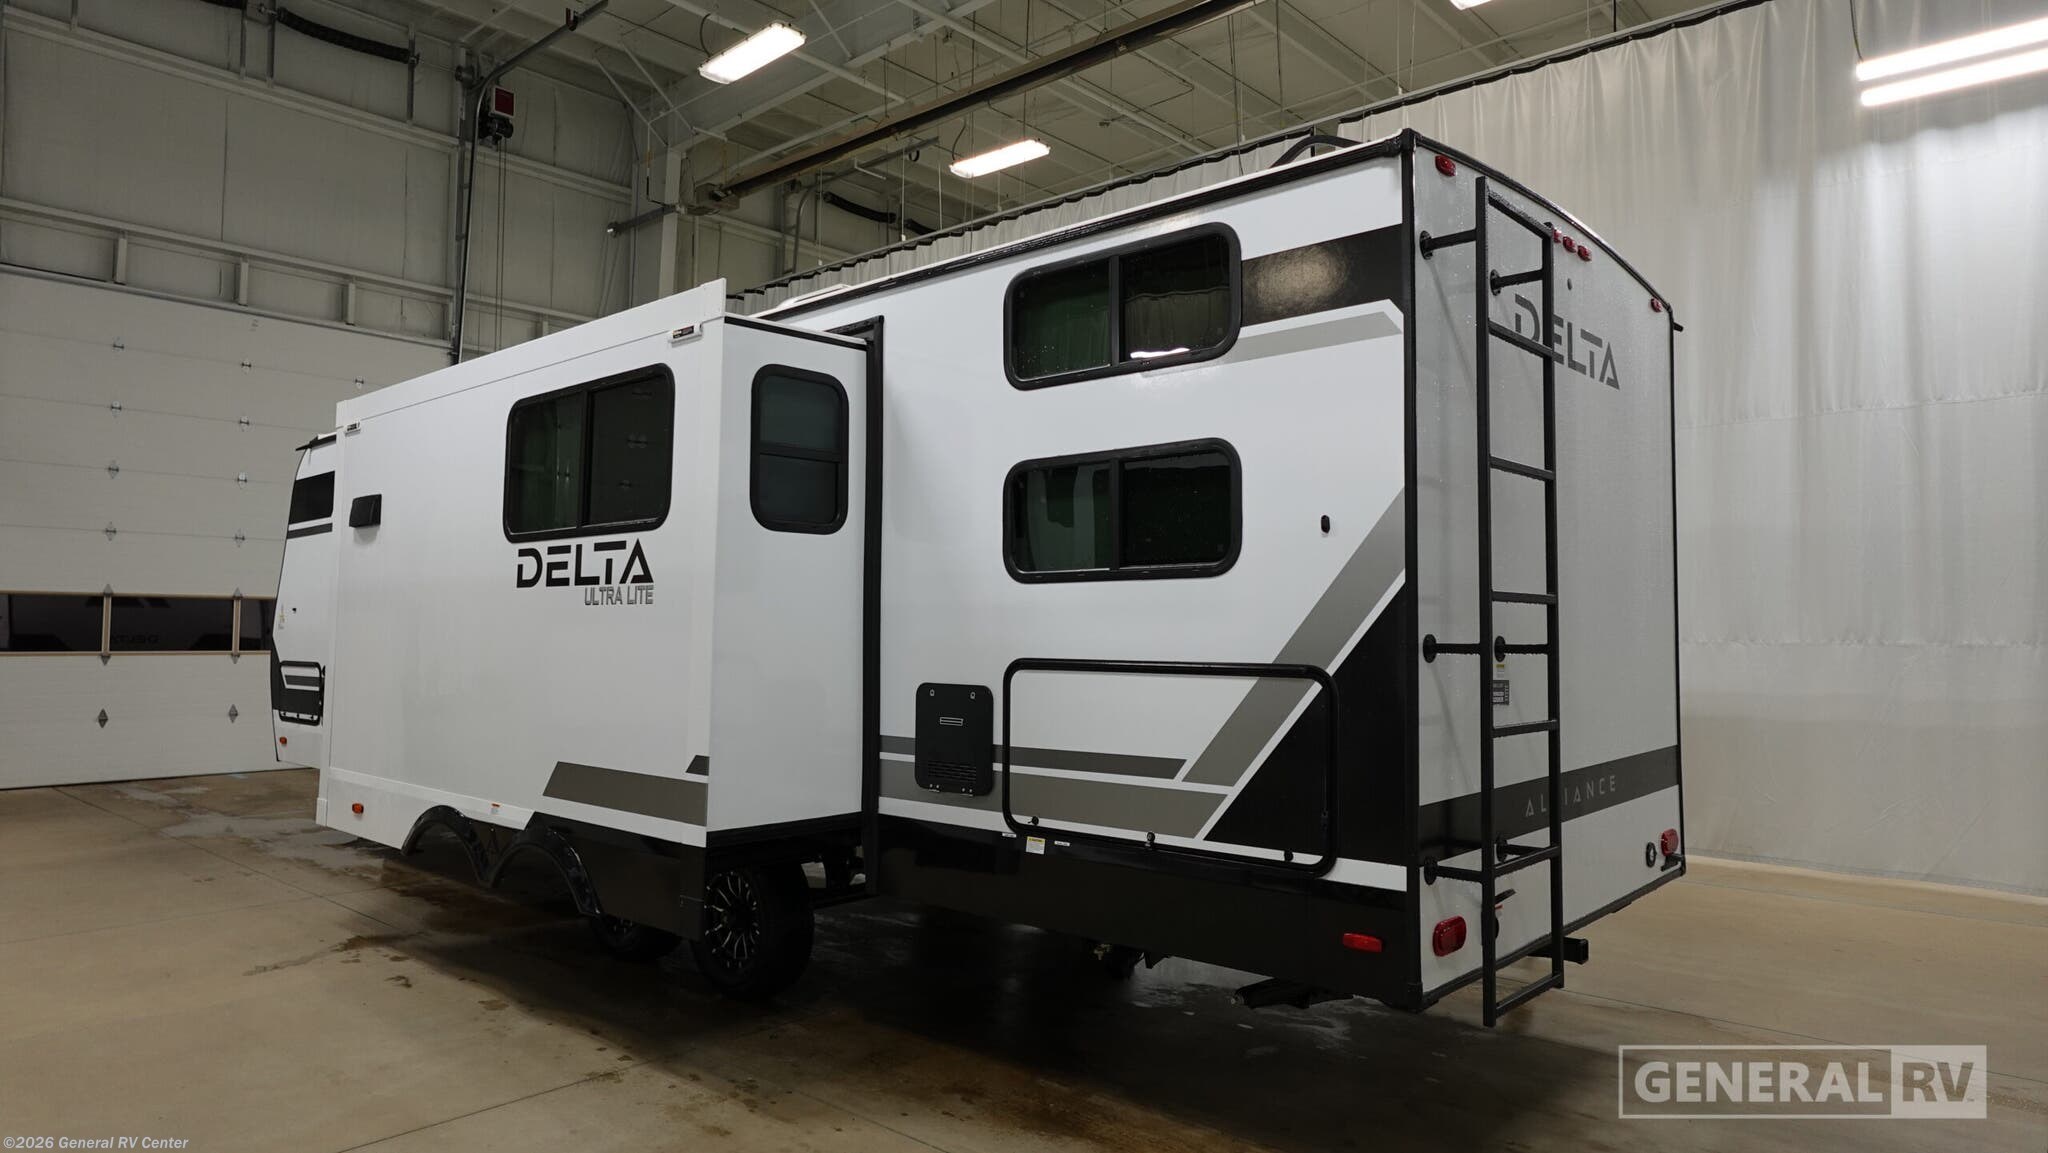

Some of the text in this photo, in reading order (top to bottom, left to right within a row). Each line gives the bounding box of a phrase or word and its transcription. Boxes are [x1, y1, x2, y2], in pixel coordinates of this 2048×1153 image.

[516, 538, 654, 588] DELTA
[584, 585, 654, 606] ULTRA LITE
[1525, 775, 1616, 818] ALIANCE
